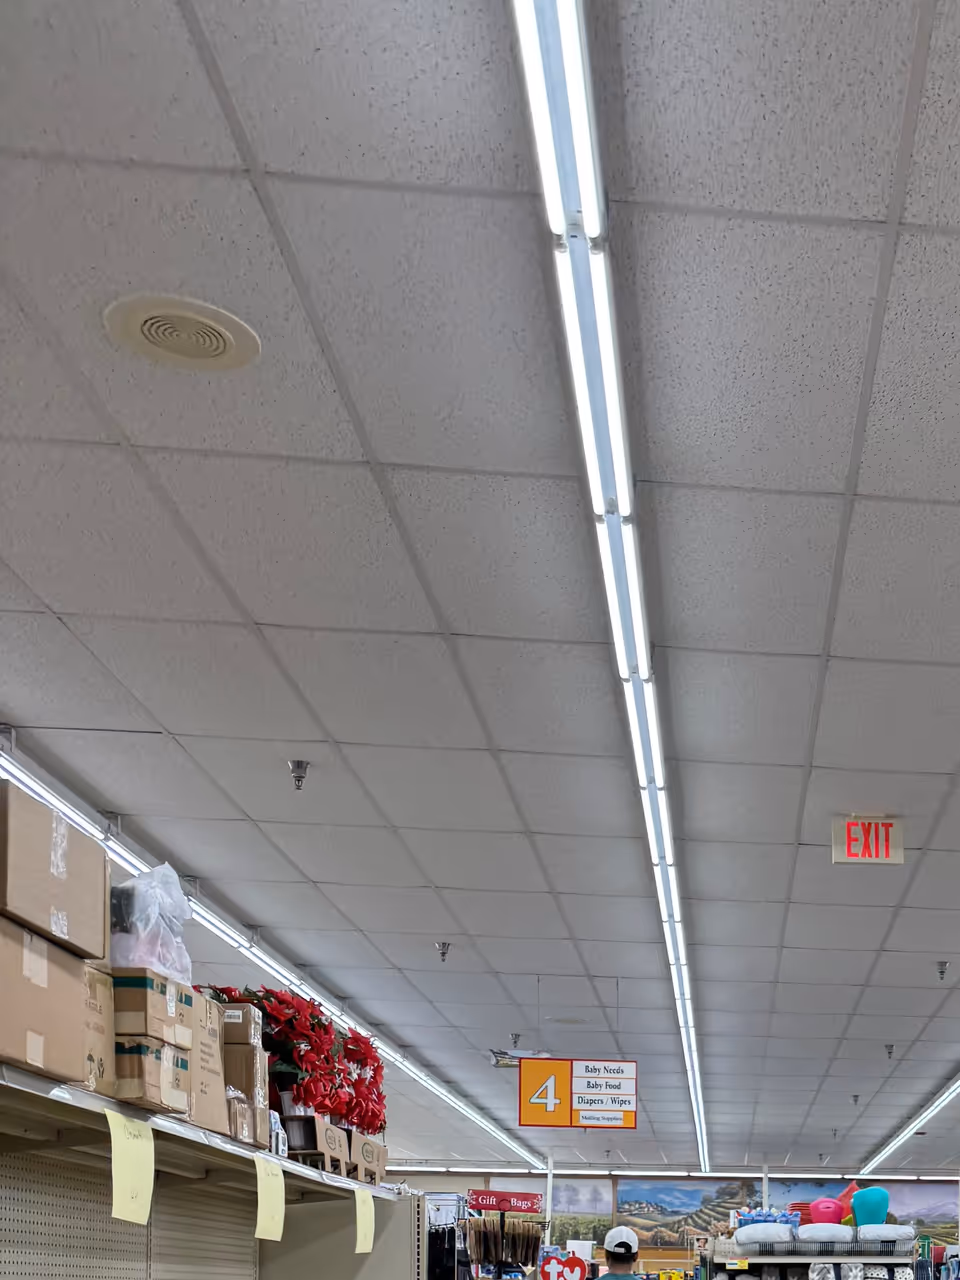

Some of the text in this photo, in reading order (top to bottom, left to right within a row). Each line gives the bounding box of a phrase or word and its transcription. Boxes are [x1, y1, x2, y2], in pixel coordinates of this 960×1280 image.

[846, 821, 894, 859] EXIT
[585, 1065, 625, 1076] Baby Needs
[586, 1080, 622, 1092] Baby Food
[528, 1073, 562, 1113] 4
[577, 1096, 604, 1107] Diapers
[610, 1096, 632, 1107] Wipes
[478, 1195, 532, 1210] Gift Bags
